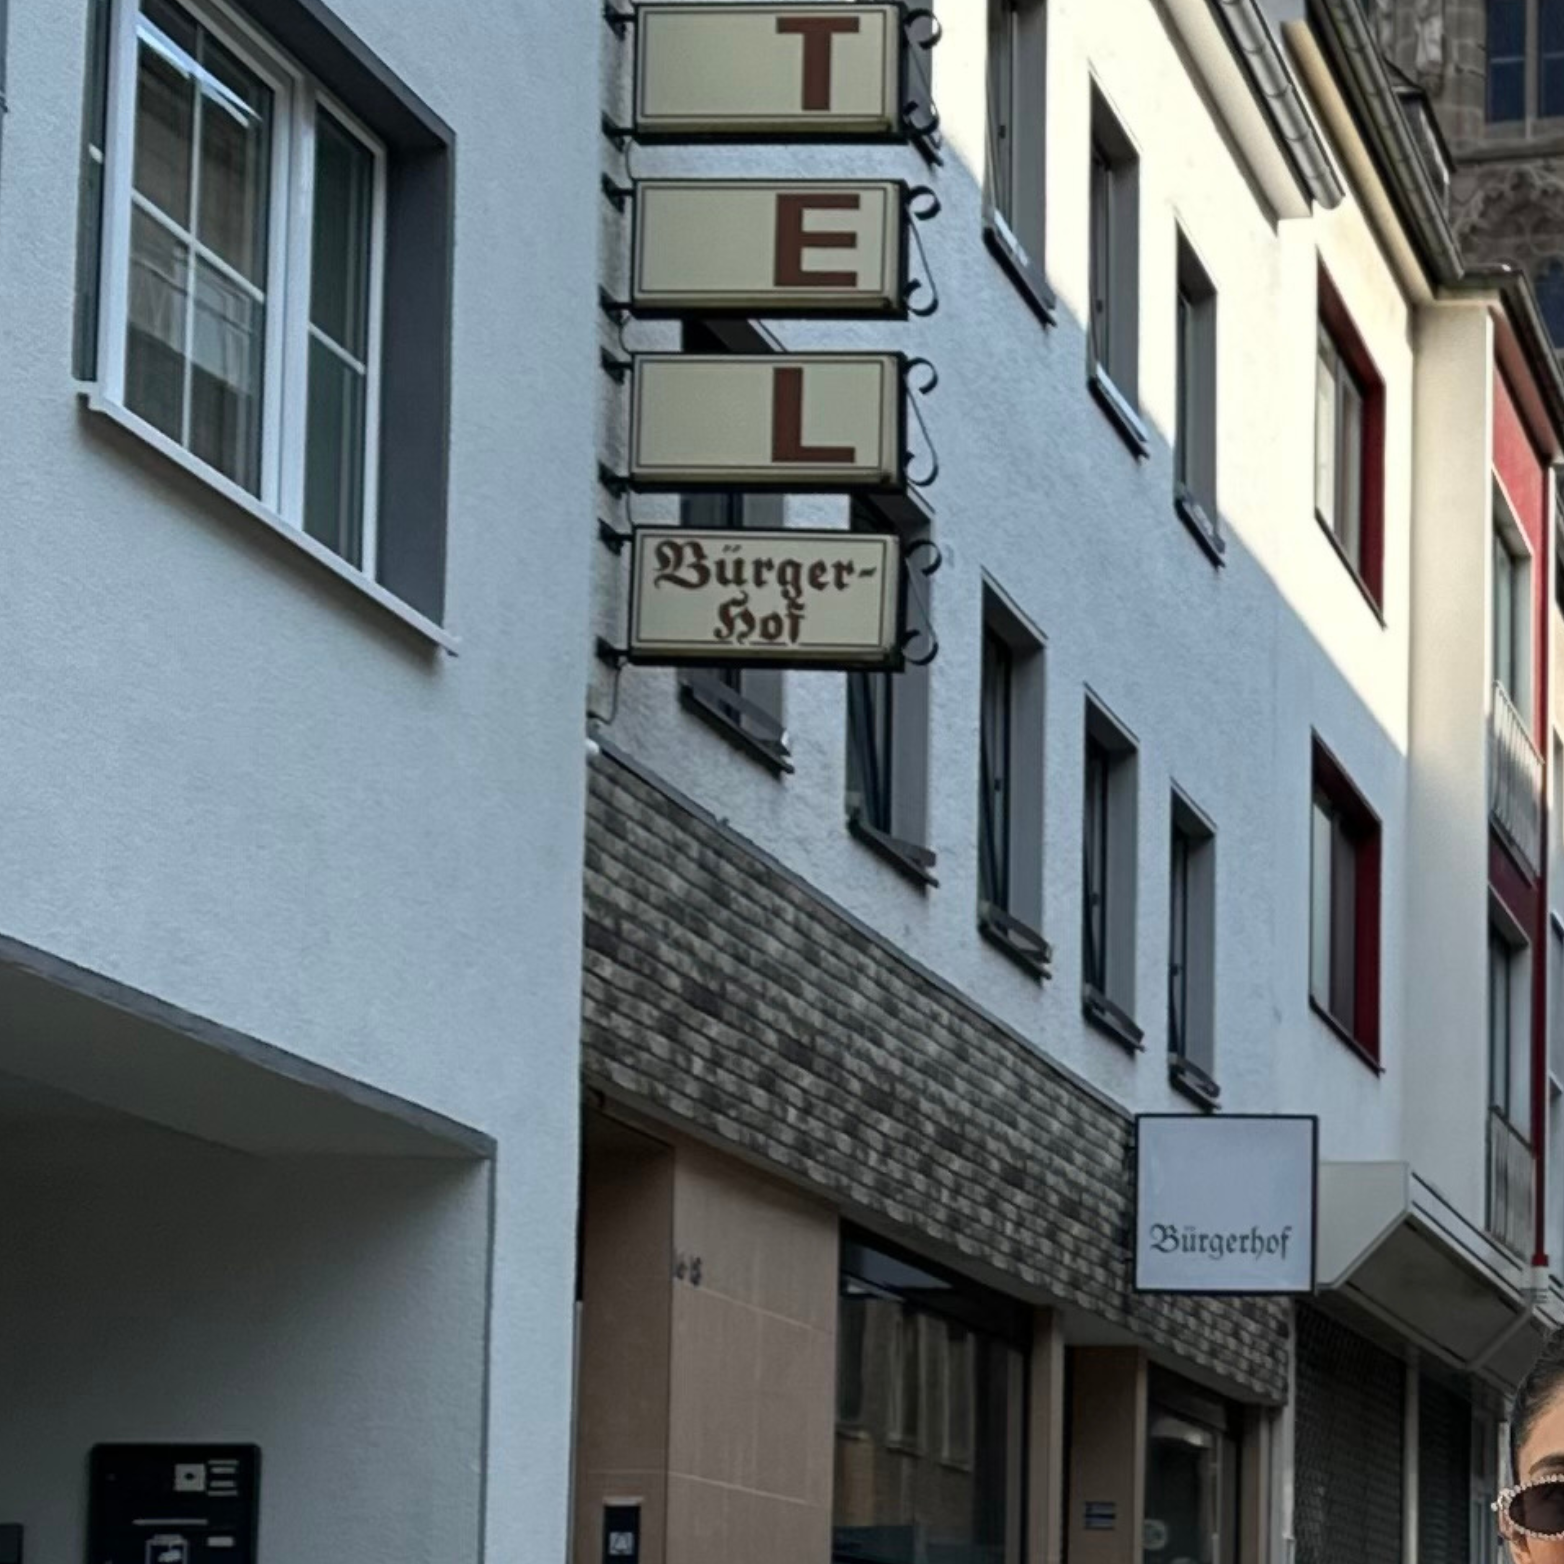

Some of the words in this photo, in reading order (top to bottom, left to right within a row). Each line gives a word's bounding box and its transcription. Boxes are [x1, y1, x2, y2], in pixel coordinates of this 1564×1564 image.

[654, 540, 877, 600] Bürger-
[714, 590, 805, 645] Hof
[1150, 1223, 1292, 1261] Bürgerhof
